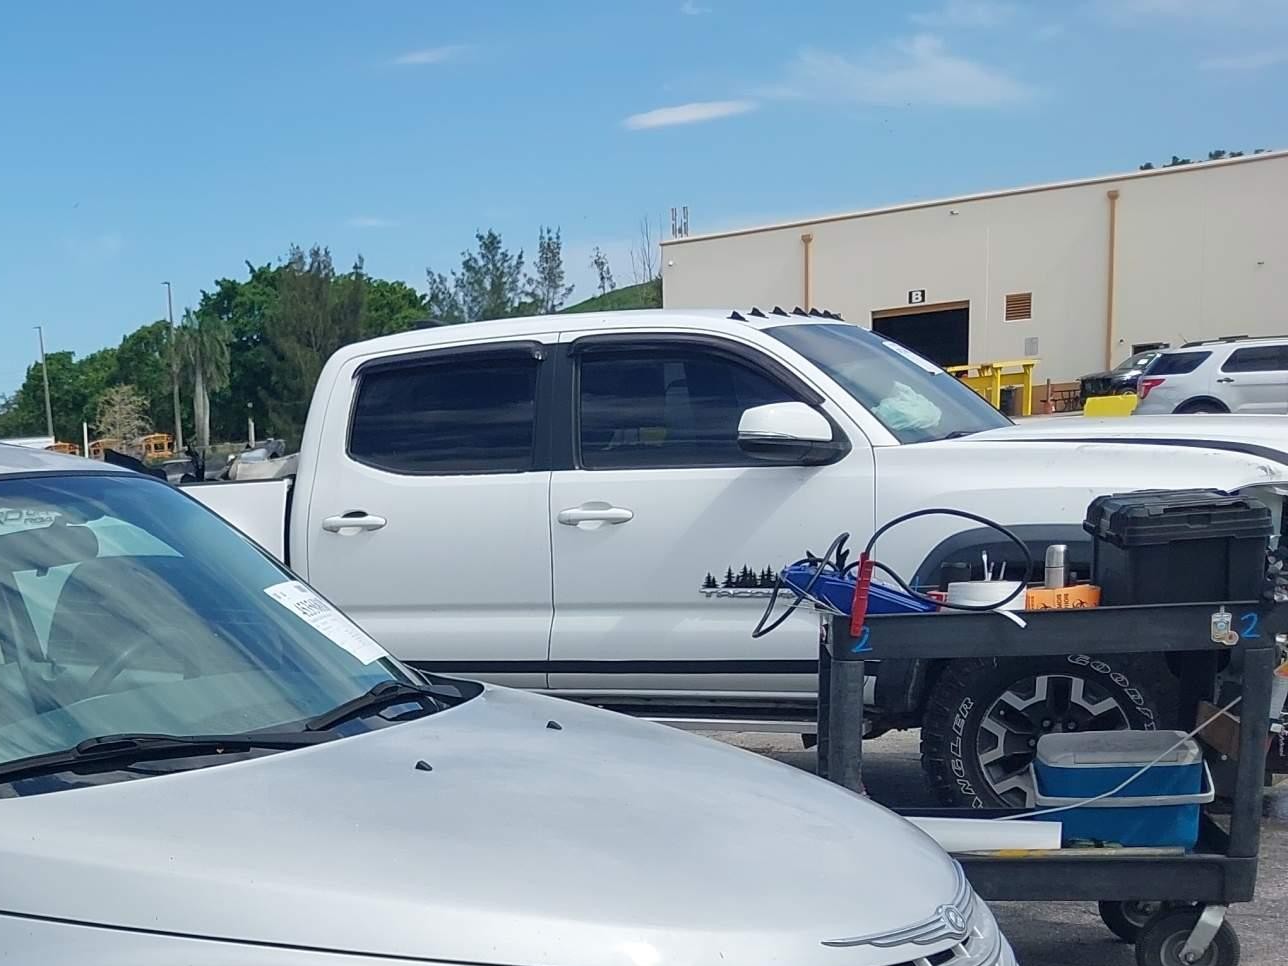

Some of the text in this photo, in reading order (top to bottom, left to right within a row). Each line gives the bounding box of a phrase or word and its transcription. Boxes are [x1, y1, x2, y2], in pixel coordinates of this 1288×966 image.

[911, 290, 923, 303] B
[1240, 612, 1261, 638] 2
[851, 625, 873, 653] 2
